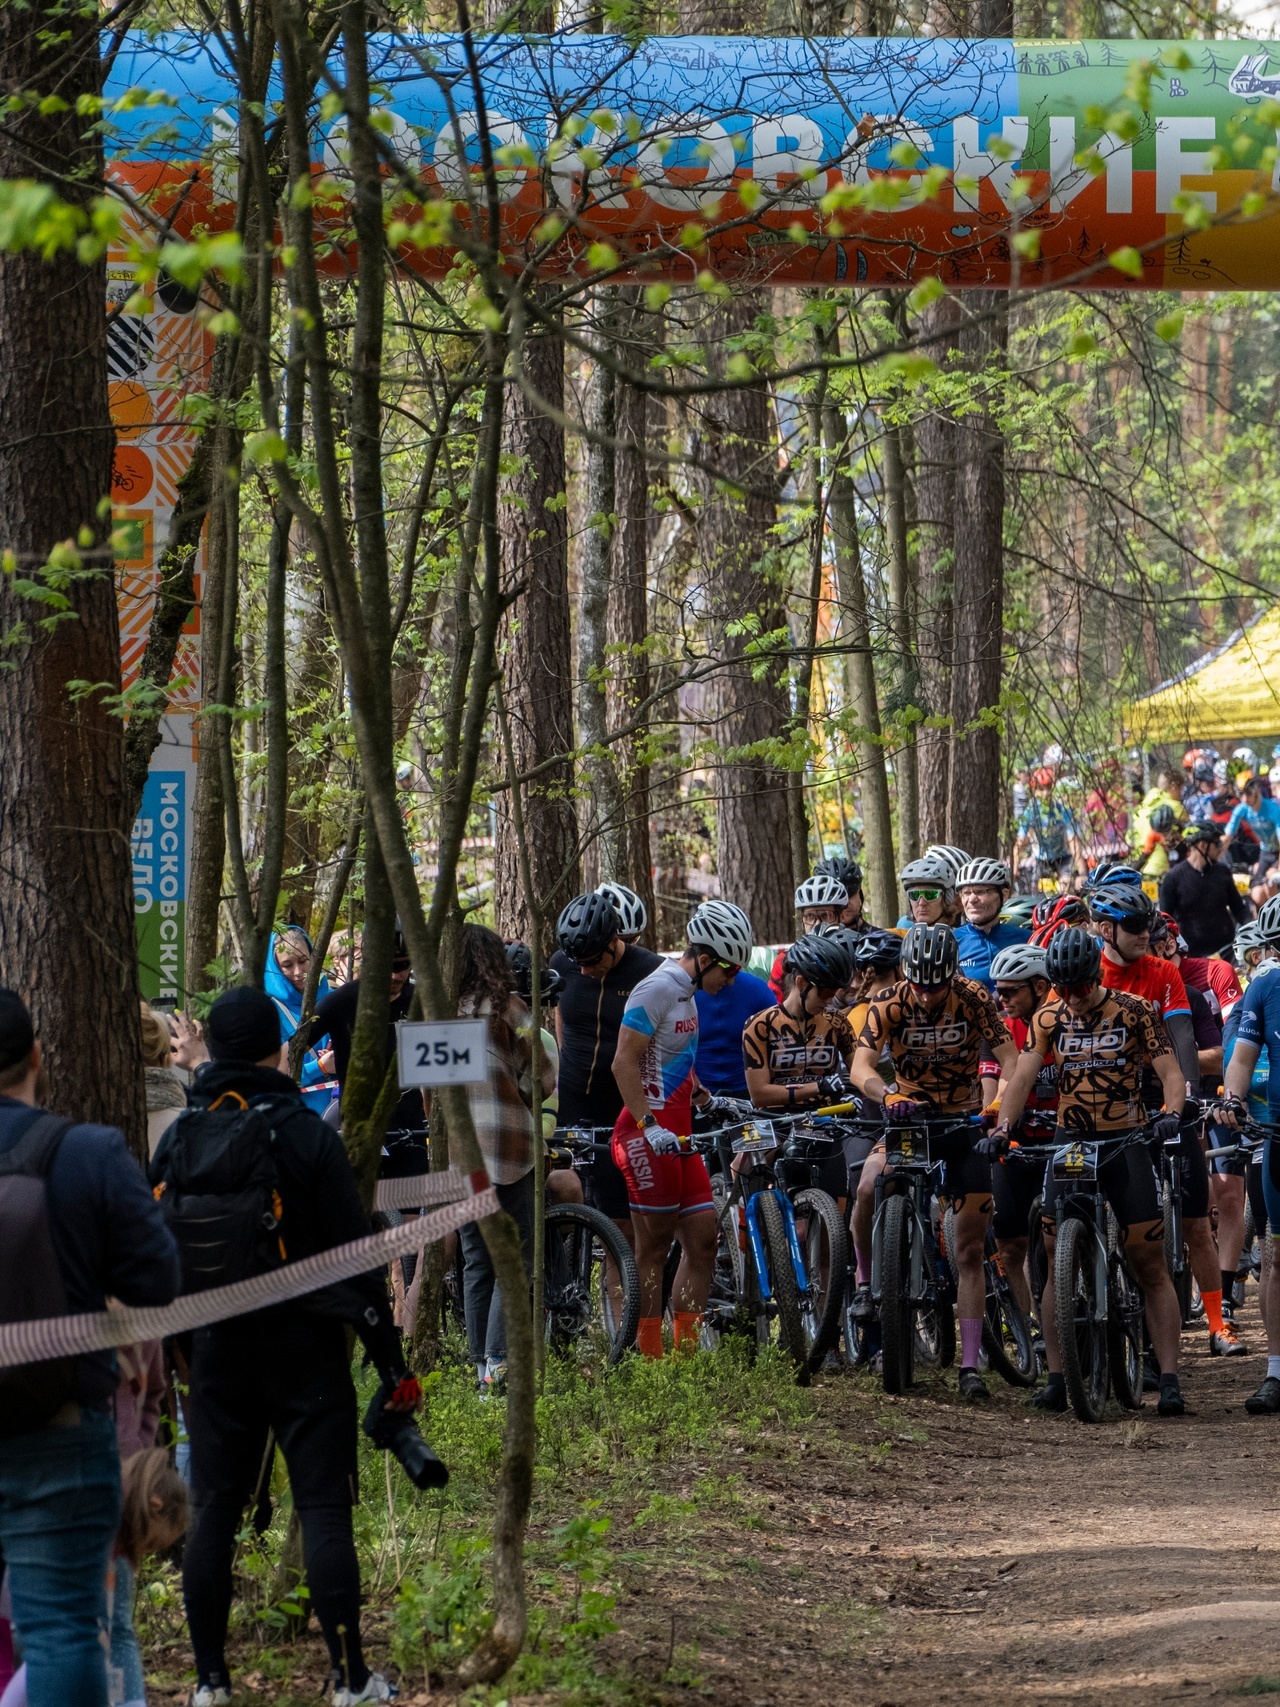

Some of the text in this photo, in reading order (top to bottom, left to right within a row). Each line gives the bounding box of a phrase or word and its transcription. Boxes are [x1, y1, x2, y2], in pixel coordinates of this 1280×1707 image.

[111, 272, 138, 280] СТАР
[131, 819, 153, 914] ВЕЛО
[160, 783, 179, 999] МОСКОВСКИЕ
[907, 1029, 961, 1045] PBO
[1237, 1026, 1261, 1036] ALUGA
[1063, 1034, 1119, 1050] PBO
[775, 1051, 831, 1066] PBO
[742, 1130, 761, 1141] 11
[901, 1141, 912, 1157] 5
[626, 1136, 655, 1191] RUSSIA
[1064, 1153, 1085, 1167] 12
